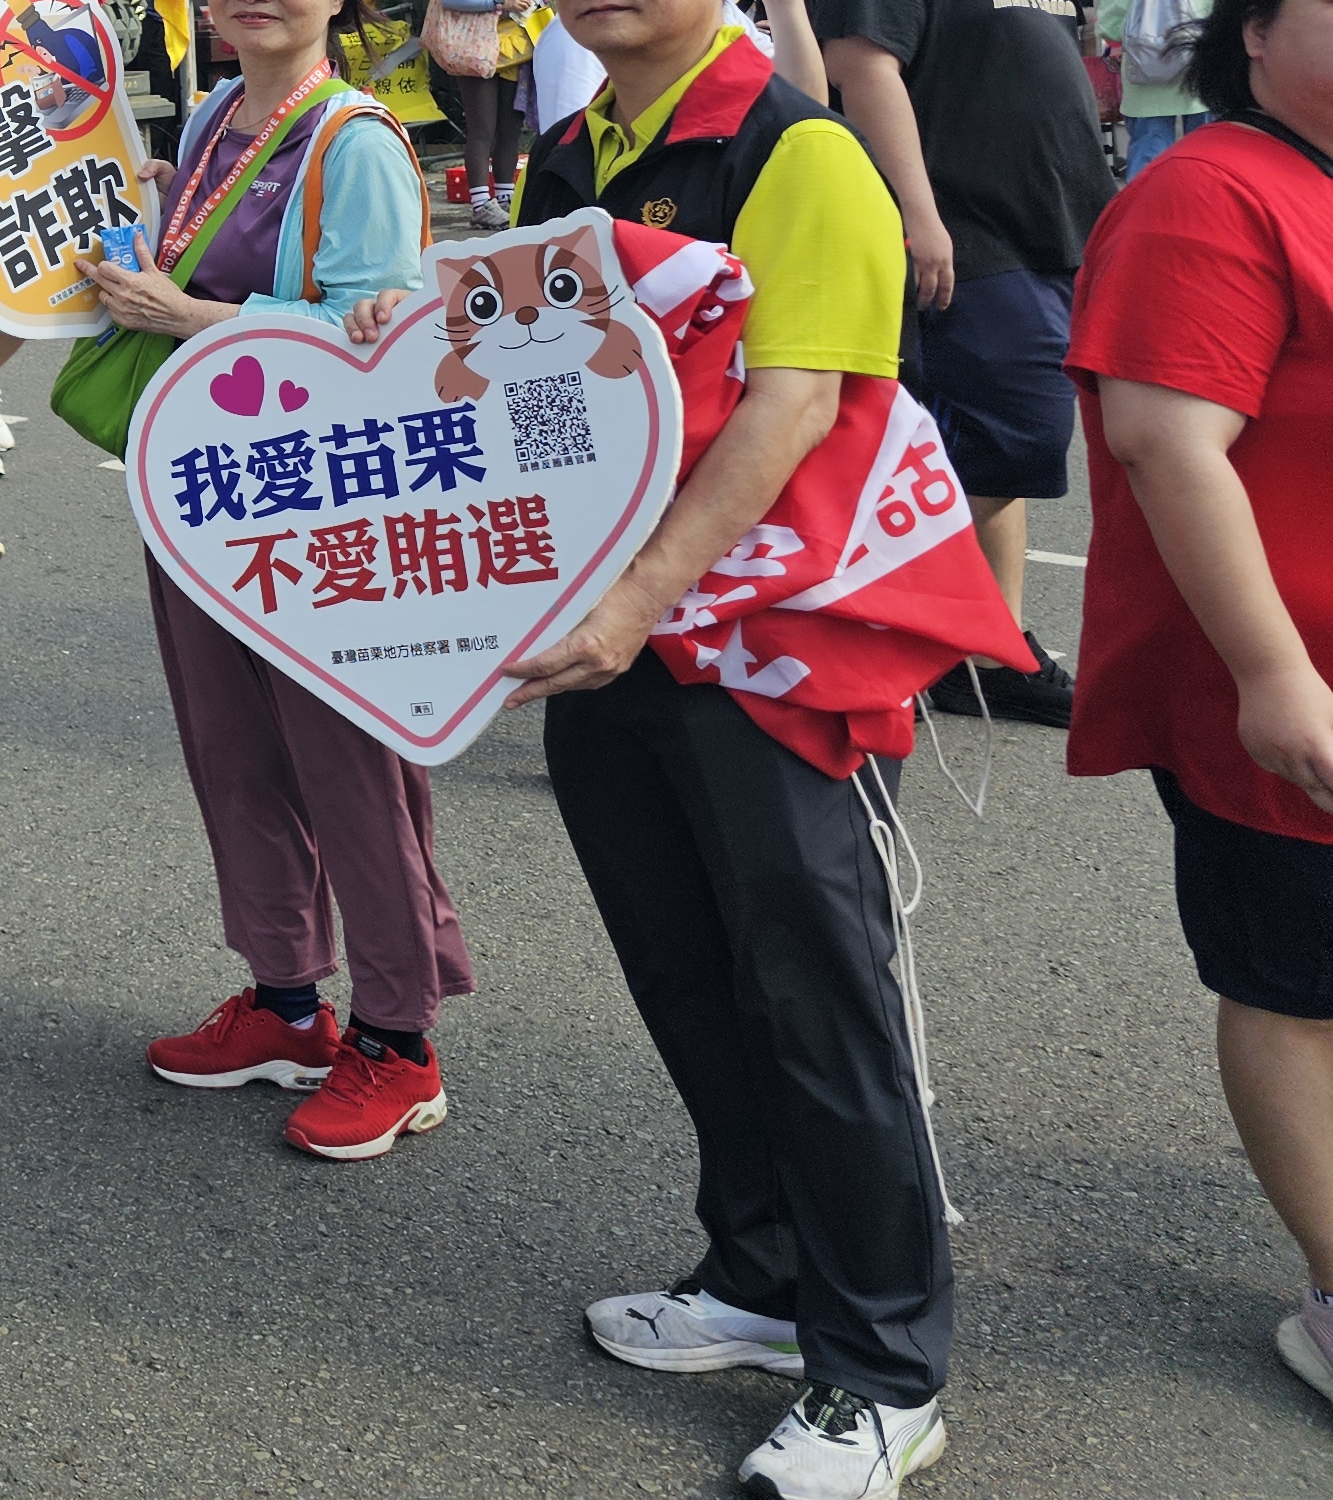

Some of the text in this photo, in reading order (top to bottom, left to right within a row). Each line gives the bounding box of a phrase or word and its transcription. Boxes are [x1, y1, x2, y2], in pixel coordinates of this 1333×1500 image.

[285, 68, 324, 107] FOSTER
[220, 147, 257, 192] FOSTER
[255, 117, 280, 147] LOVE
[160, 201, 214, 272] FOSTER LOVE
[169, 401, 487, 529] 我愛苗栗
[224, 493, 560, 615] 不愛賄選
[331, 634, 500, 665] 臺灣苗栗地方檢察署 關心您
